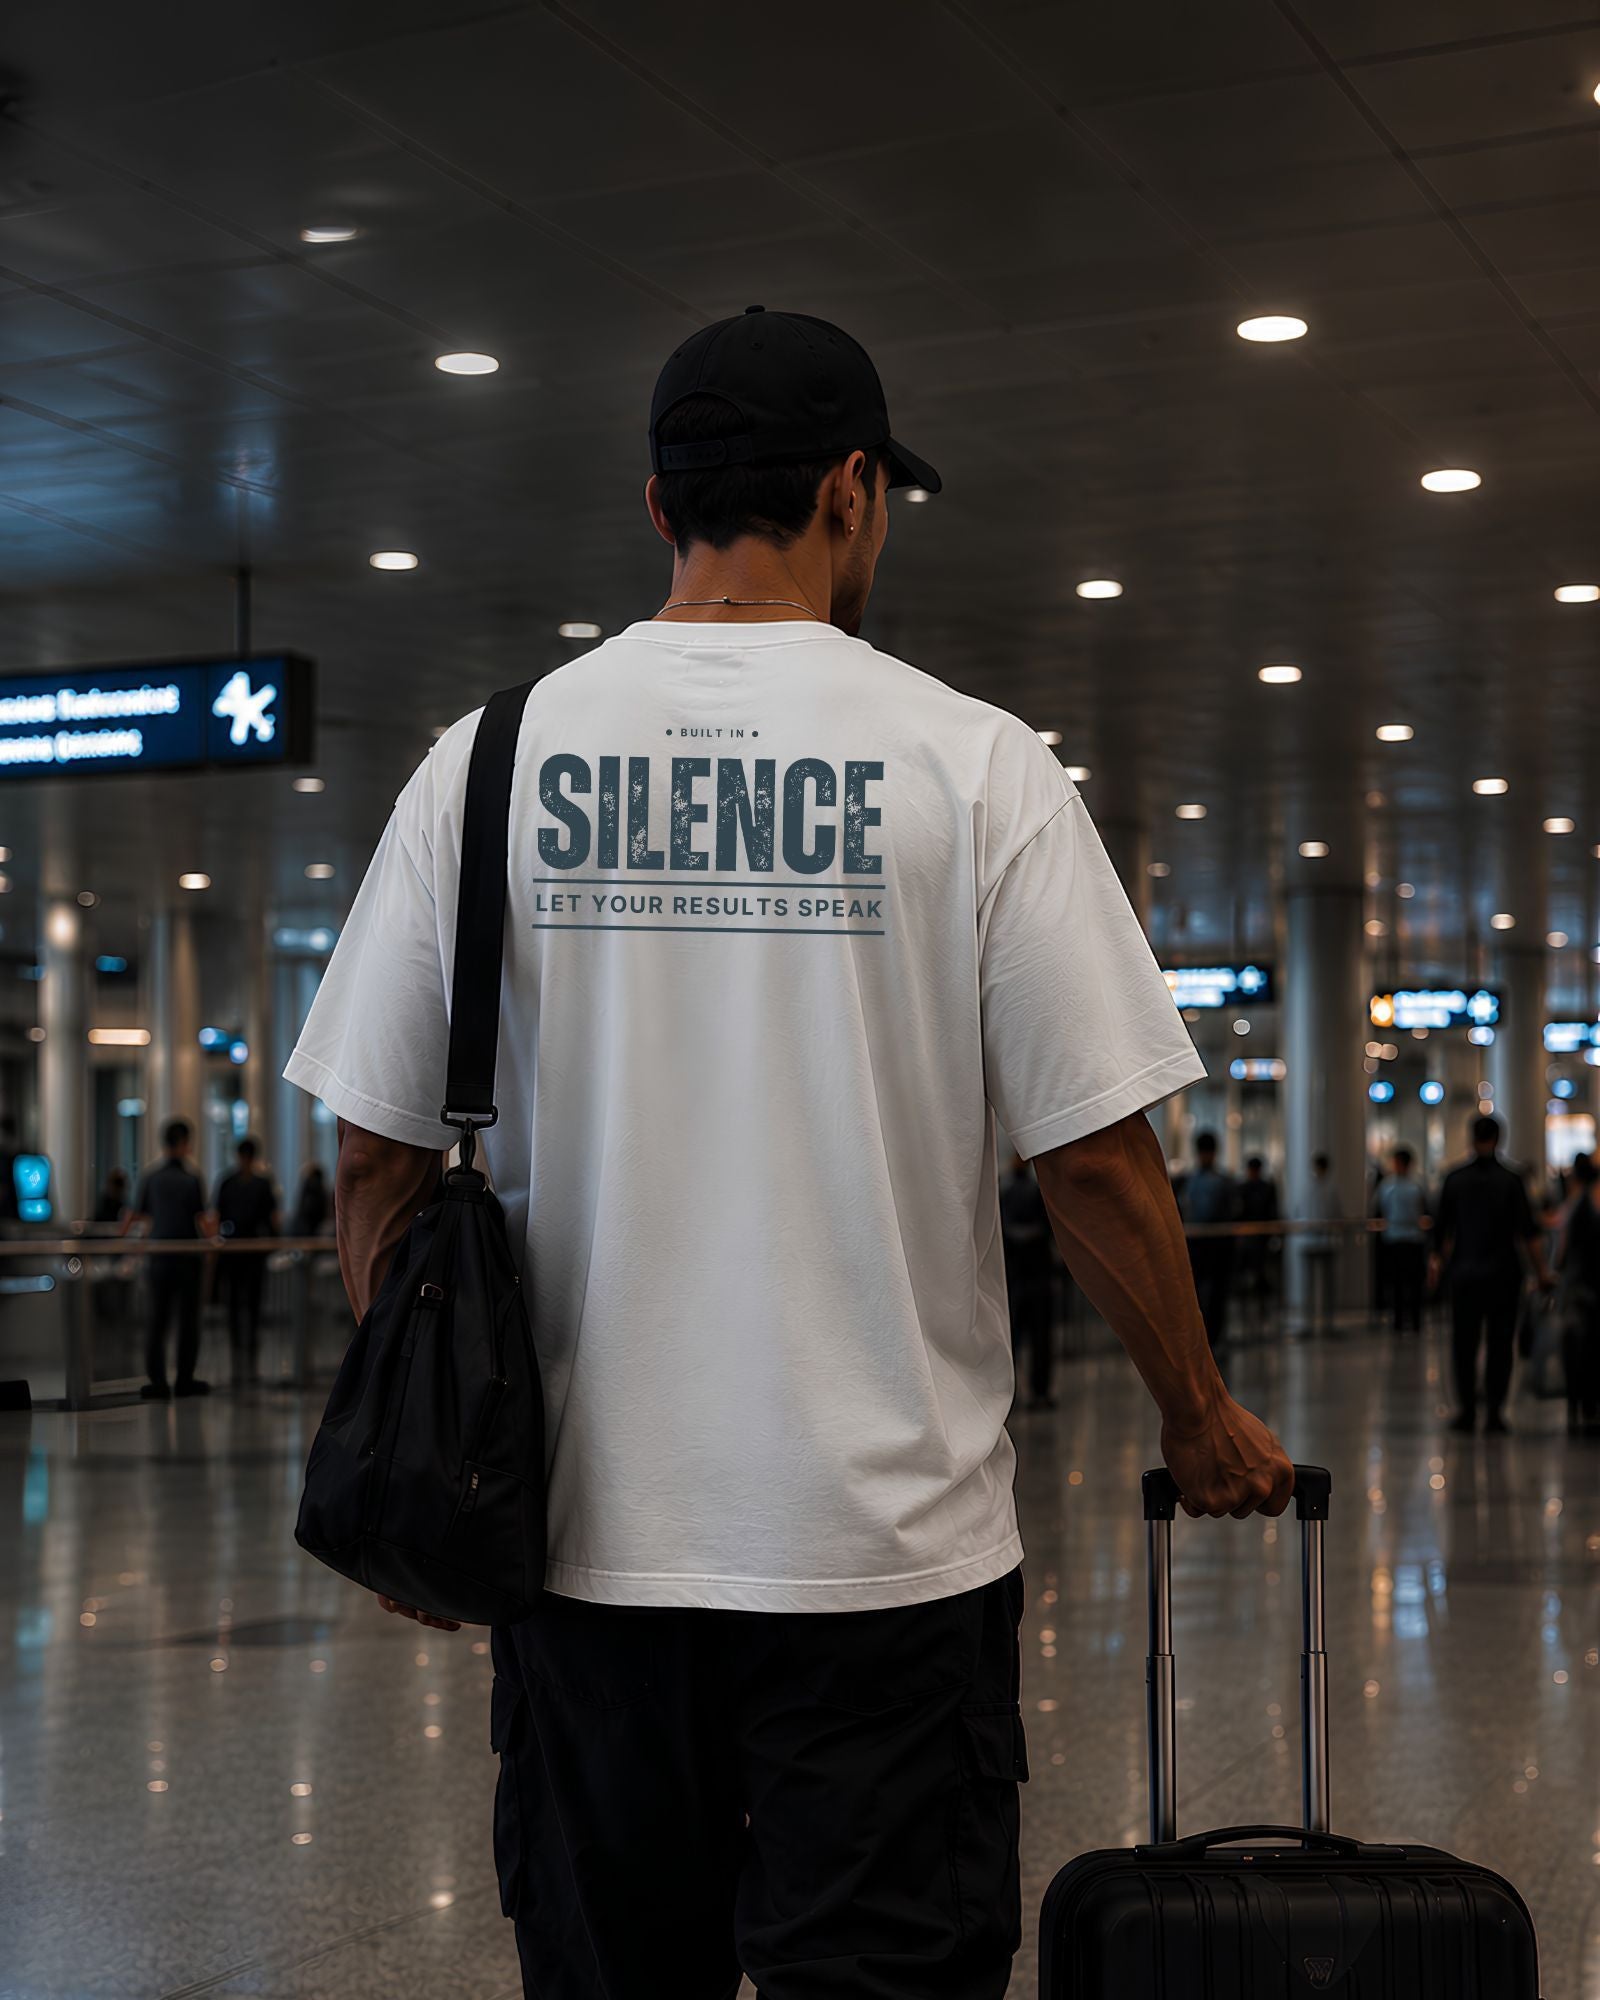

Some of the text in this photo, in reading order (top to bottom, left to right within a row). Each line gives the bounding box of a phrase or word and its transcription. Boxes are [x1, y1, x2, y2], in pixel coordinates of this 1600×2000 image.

[680, 728, 745, 738] BUILT IN
[537, 753, 885, 874] SILENCE
[535, 893, 883, 919] LET YOUR RESULTS SPEAK
